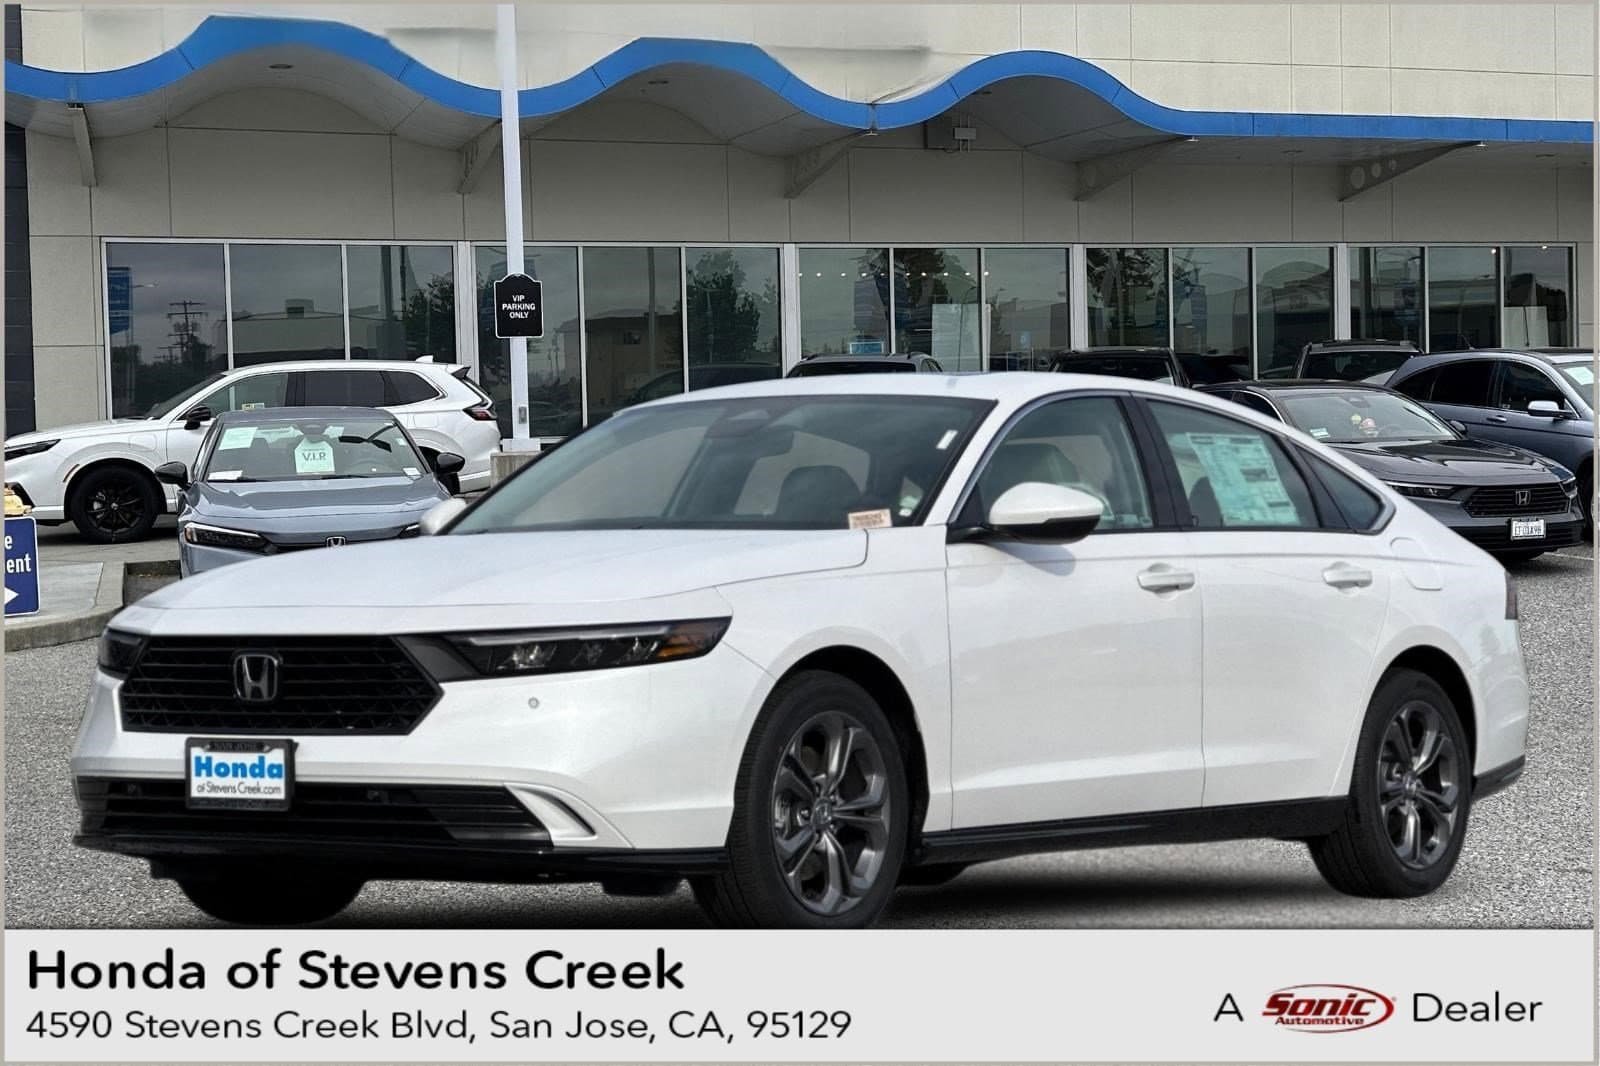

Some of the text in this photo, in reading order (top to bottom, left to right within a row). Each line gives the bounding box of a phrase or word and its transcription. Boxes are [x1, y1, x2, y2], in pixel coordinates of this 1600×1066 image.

[509, 311, 529, 319] ONLY
[6, 553, 32, 574] ent
[194, 755, 283, 779] Honda
[196, 782, 206, 793] of
